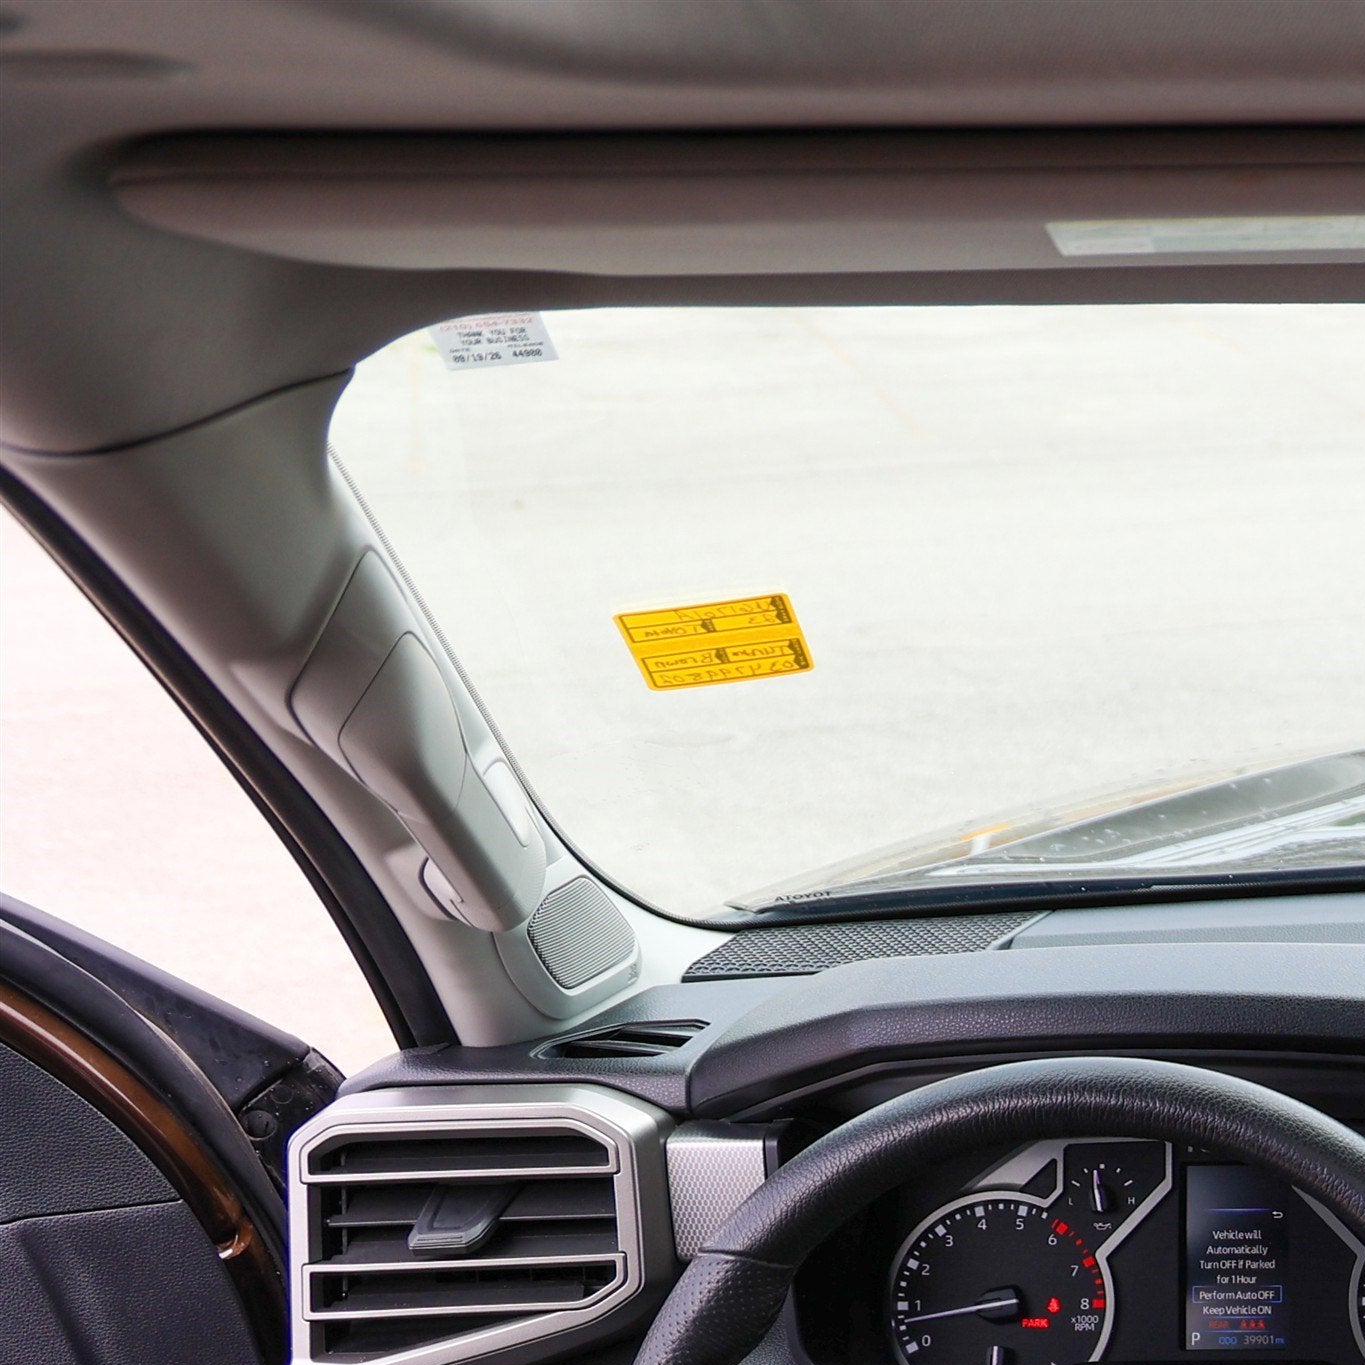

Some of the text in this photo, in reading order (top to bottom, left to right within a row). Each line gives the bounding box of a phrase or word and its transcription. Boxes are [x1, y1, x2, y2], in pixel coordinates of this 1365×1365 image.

[977, 1220, 988, 1230] 4
[1016, 1219, 1024, 1230] 5
[1048, 1234, 1057, 1246] 6
[1212, 1230, 1262, 1240] Vehicle will
[945, 1235, 954, 1247] 3
[1206, 1245, 1268, 1256] Automatically
[1200, 1260, 1275, 1269] Turn OFF Parked
[921, 1264, 930, 1276] 2
[1070, 1265, 1079, 1277] 7
[1216, 1275, 1257, 1284] for Hour
[1199, 1291, 1275, 1300] Perform Auto OFF
[914, 1300, 921, 1311] 1
[1080, 1298, 1089, 1309] 8
[1202, 1306, 1272, 1316] Keep Vehicle ON
[1022, 1318, 1048, 1328] PARK
[1070, 1315, 1099, 1324] x1000
[1074, 1323, 1095, 1332] RPM
[922, 1335, 931, 1346] 0
[1191, 1332, 1201, 1346] P
[1243, 1335, 1274, 1345] 39901
